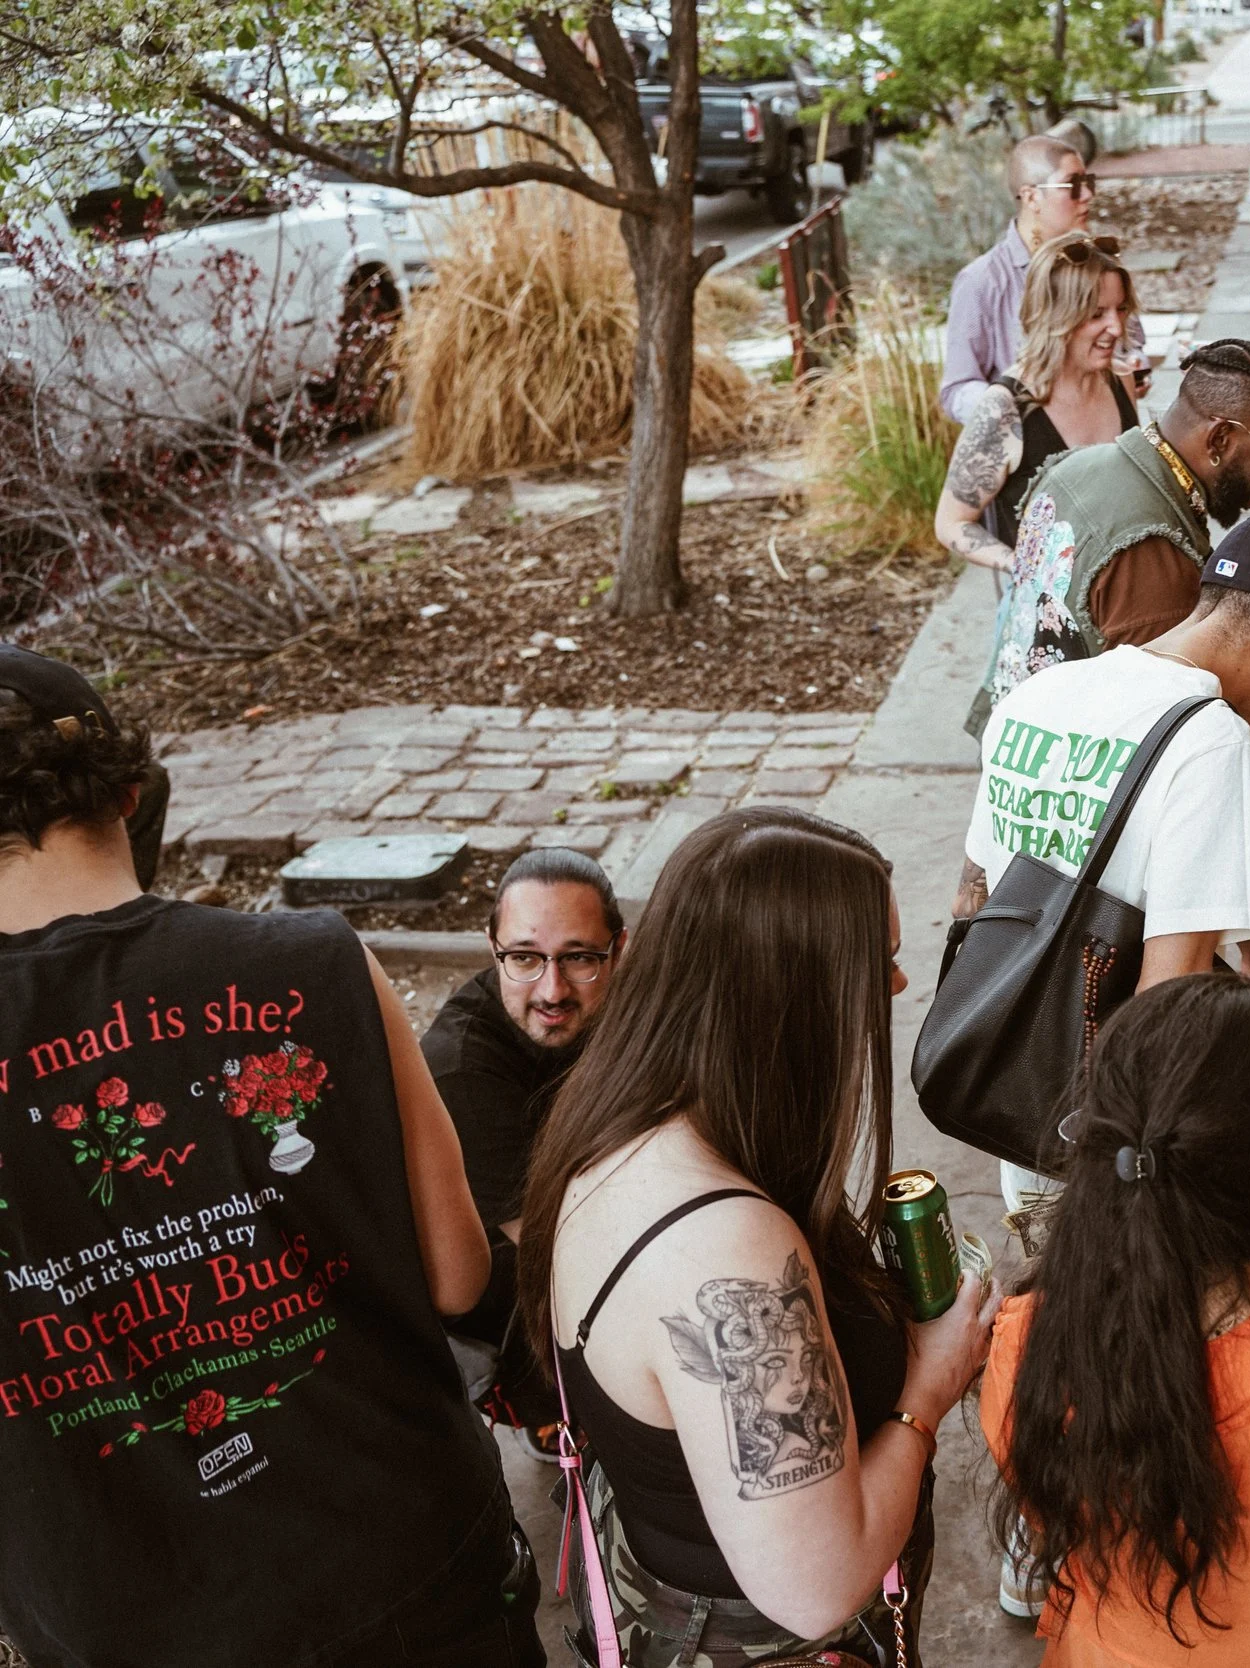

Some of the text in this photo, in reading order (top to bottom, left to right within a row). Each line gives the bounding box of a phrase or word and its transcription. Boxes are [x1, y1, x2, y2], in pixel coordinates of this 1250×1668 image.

[1060, 732, 1140, 789] HOP
[27, 1000, 133, 1079] mad
[147, 996, 186, 1041] is
[204, 984, 304, 1034] she?
[28, 1107, 42, 1123] B
[190, 1081, 204, 1097] C
[4, 1186, 285, 1292] Might not fix the problem,
[57, 1223, 256, 1306] but it's worth a try
[19, 1230, 309, 1361] Totally Buds
[0, 1351, 116, 1418] Floral
[47, 1315, 338, 1437] Portland Clackamas Seattle
[201, 1436, 249, 1474] OPEN
[210, 1479, 237, 1497] habla
